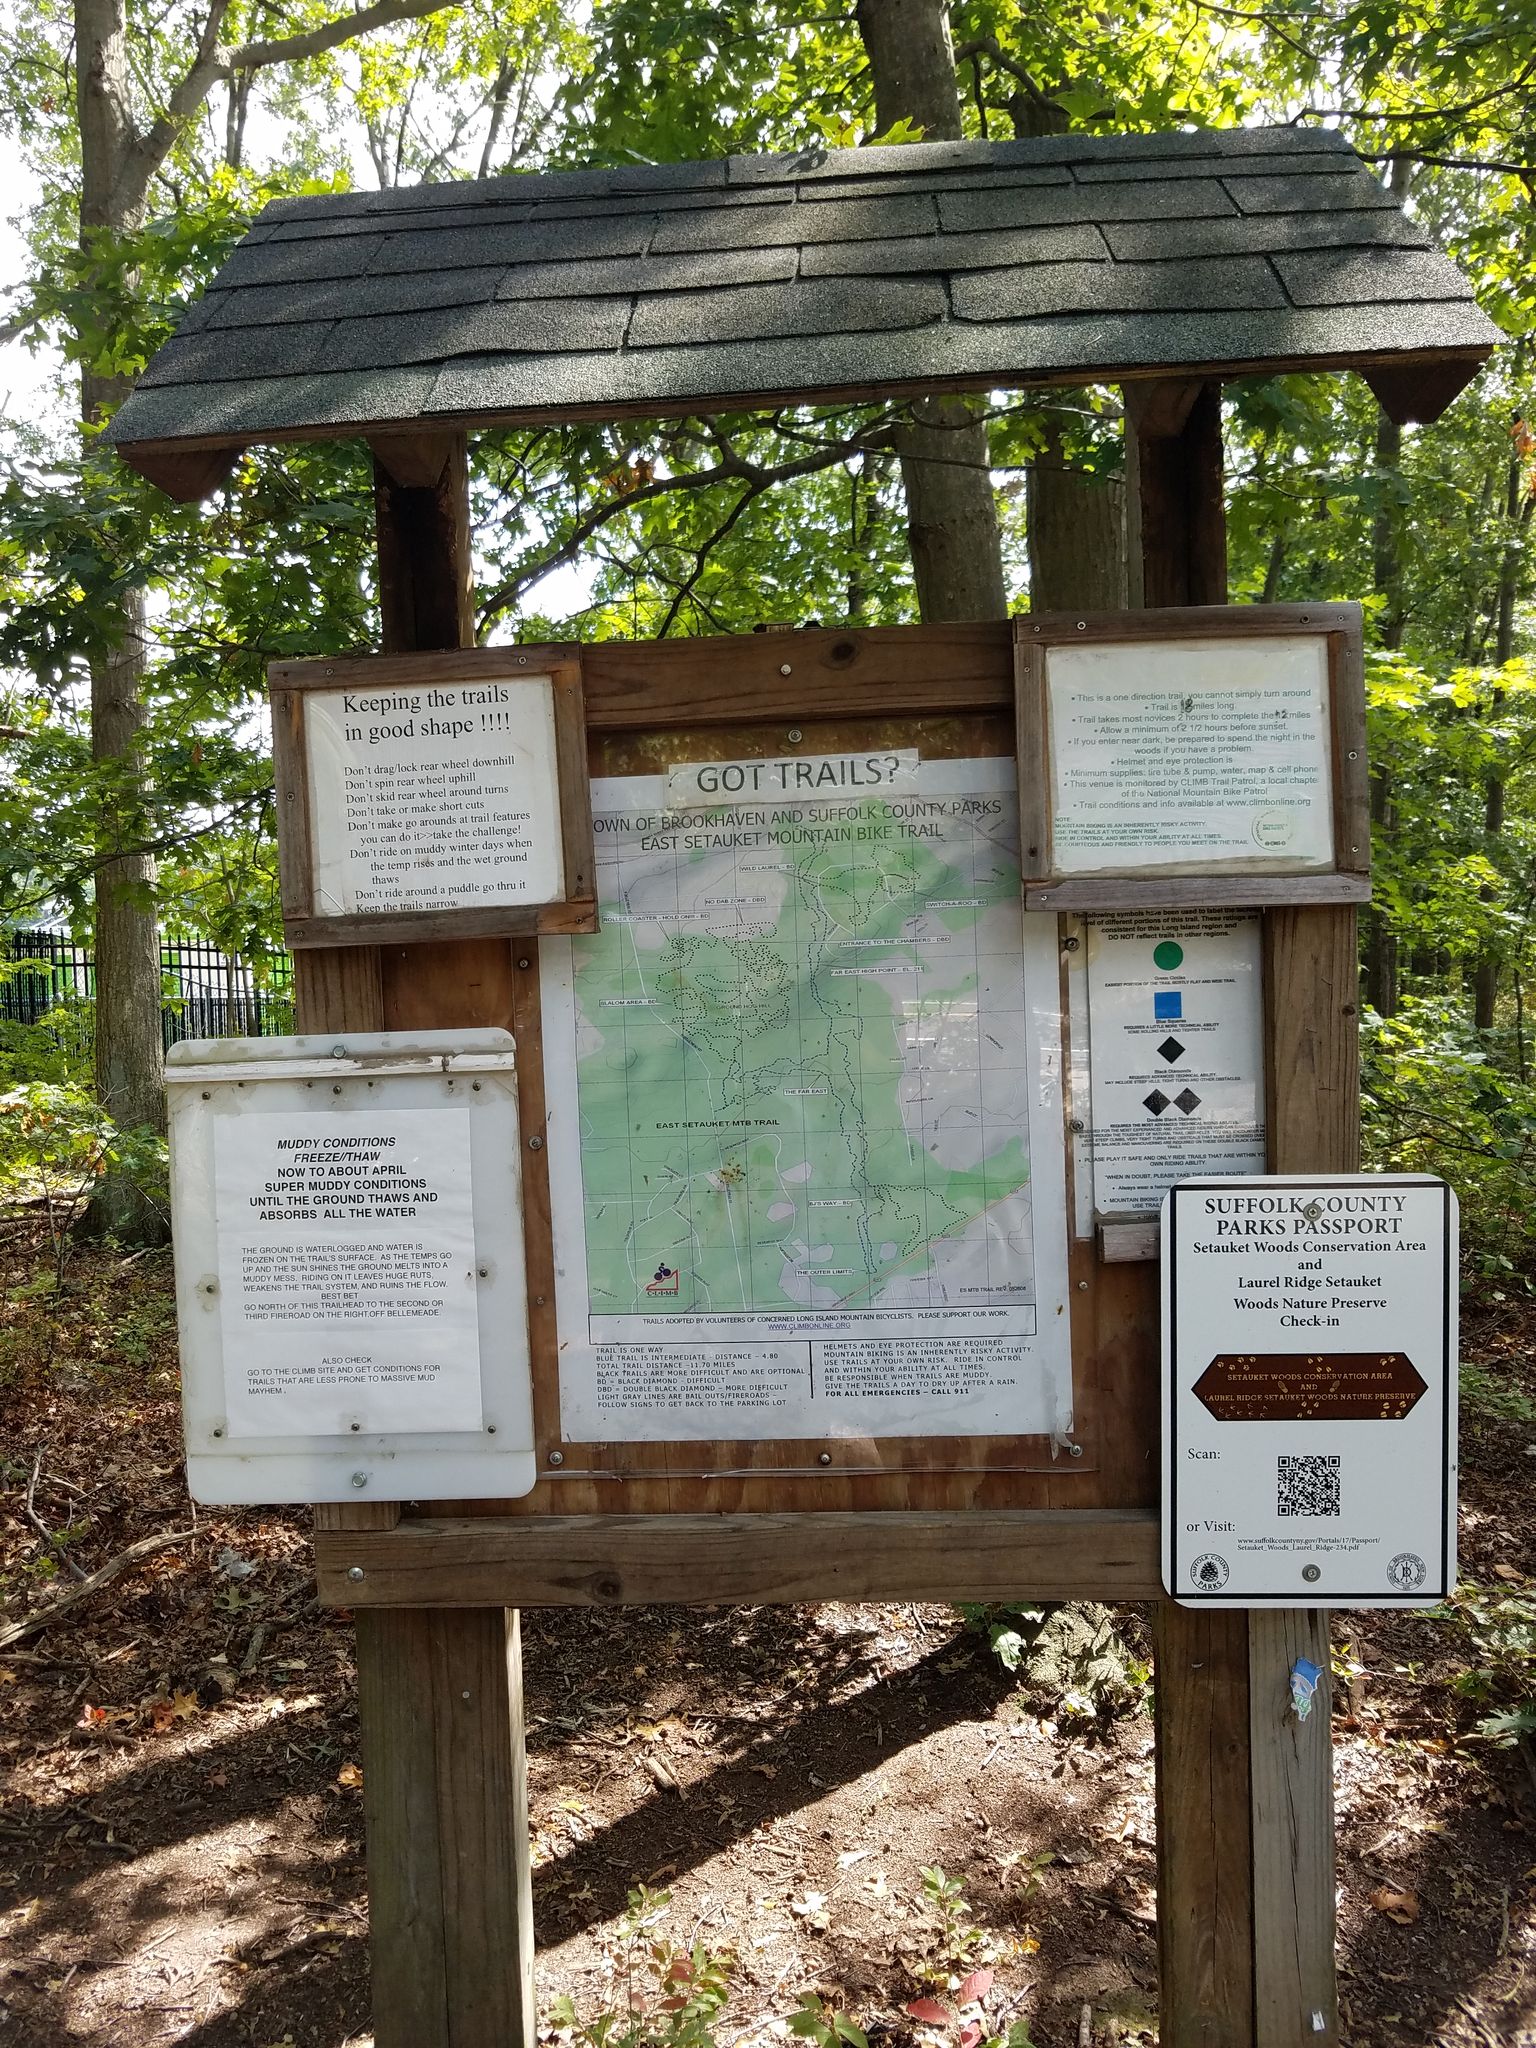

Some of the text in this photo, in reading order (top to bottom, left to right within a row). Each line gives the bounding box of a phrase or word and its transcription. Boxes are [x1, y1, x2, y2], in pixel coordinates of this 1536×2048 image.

[342, 685, 508, 715] Keeping the trails
[1130, 692, 1166, 700] direction
[1235, 690, 1262, 699] simply
[345, 712, 509, 744] in good shape !!!!
[344, 765, 371, 776] Don't
[373, 762, 417, 775] drag/lock
[441, 758, 469, 769] wheel
[472, 755, 514, 767] downhill
[1183, 756, 1224, 765] protection
[345, 779, 372, 789] Don't
[374, 778, 394, 789] spin
[417, 774, 445, 784] wheel
[448, 772, 475, 785] uphill
[697, 756, 900, 792] GOT TRAILS?
[1079, 800, 1096, 809] Trail
[1098, 800, 1140, 808] conditions
[1142, 800, 1158, 808] and
[1177, 799, 1214, 807] available
[1226, 798, 1311, 806] www.climbonline.org
[593, 800, 1001, 832] OWN OF BROOKHAVEN AND SUFFOLK COUNTY PARKS
[642, 824, 943, 850] EAST SETAUKET MOUNTAIN BIKE TRAIL
[356, 900, 458, 913] Keep the trails narrow
[277, 1137, 396, 1149] MUDDY CONDITIONS
[294, 1151, 380, 1162] FREEZE//THAW
[278, 1165, 406, 1177] NOW TO ABOUT APRIL
[265, 1179, 426, 1192] SUPER MUDDY CONDITIONS
[249, 1192, 438, 1206] UNTIL THE GROUND THAWS AND
[1204, 1196, 1406, 1214] SUFFOLK COUNTY
[259, 1207, 416, 1220] ABSORBS ALL THE WATER
[1216, 1218, 1402, 1235] PARKS PASSPORT
[1193, 1240, 1426, 1253] Setauket Woods Conservation Area
[1297, 1258, 1322, 1270] and
[1238, 1275, 1381, 1291] Laurel Ridge Setauket
[1233, 1297, 1387, 1309] Woods Nature Preserve
[1280, 1315, 1339, 1326] Check-in
[1187, 1448, 1220, 1459] Scan:
[1186, 1520, 1235, 1531] or Visit:
[1198, 1581, 1222, 1589] PARKS
